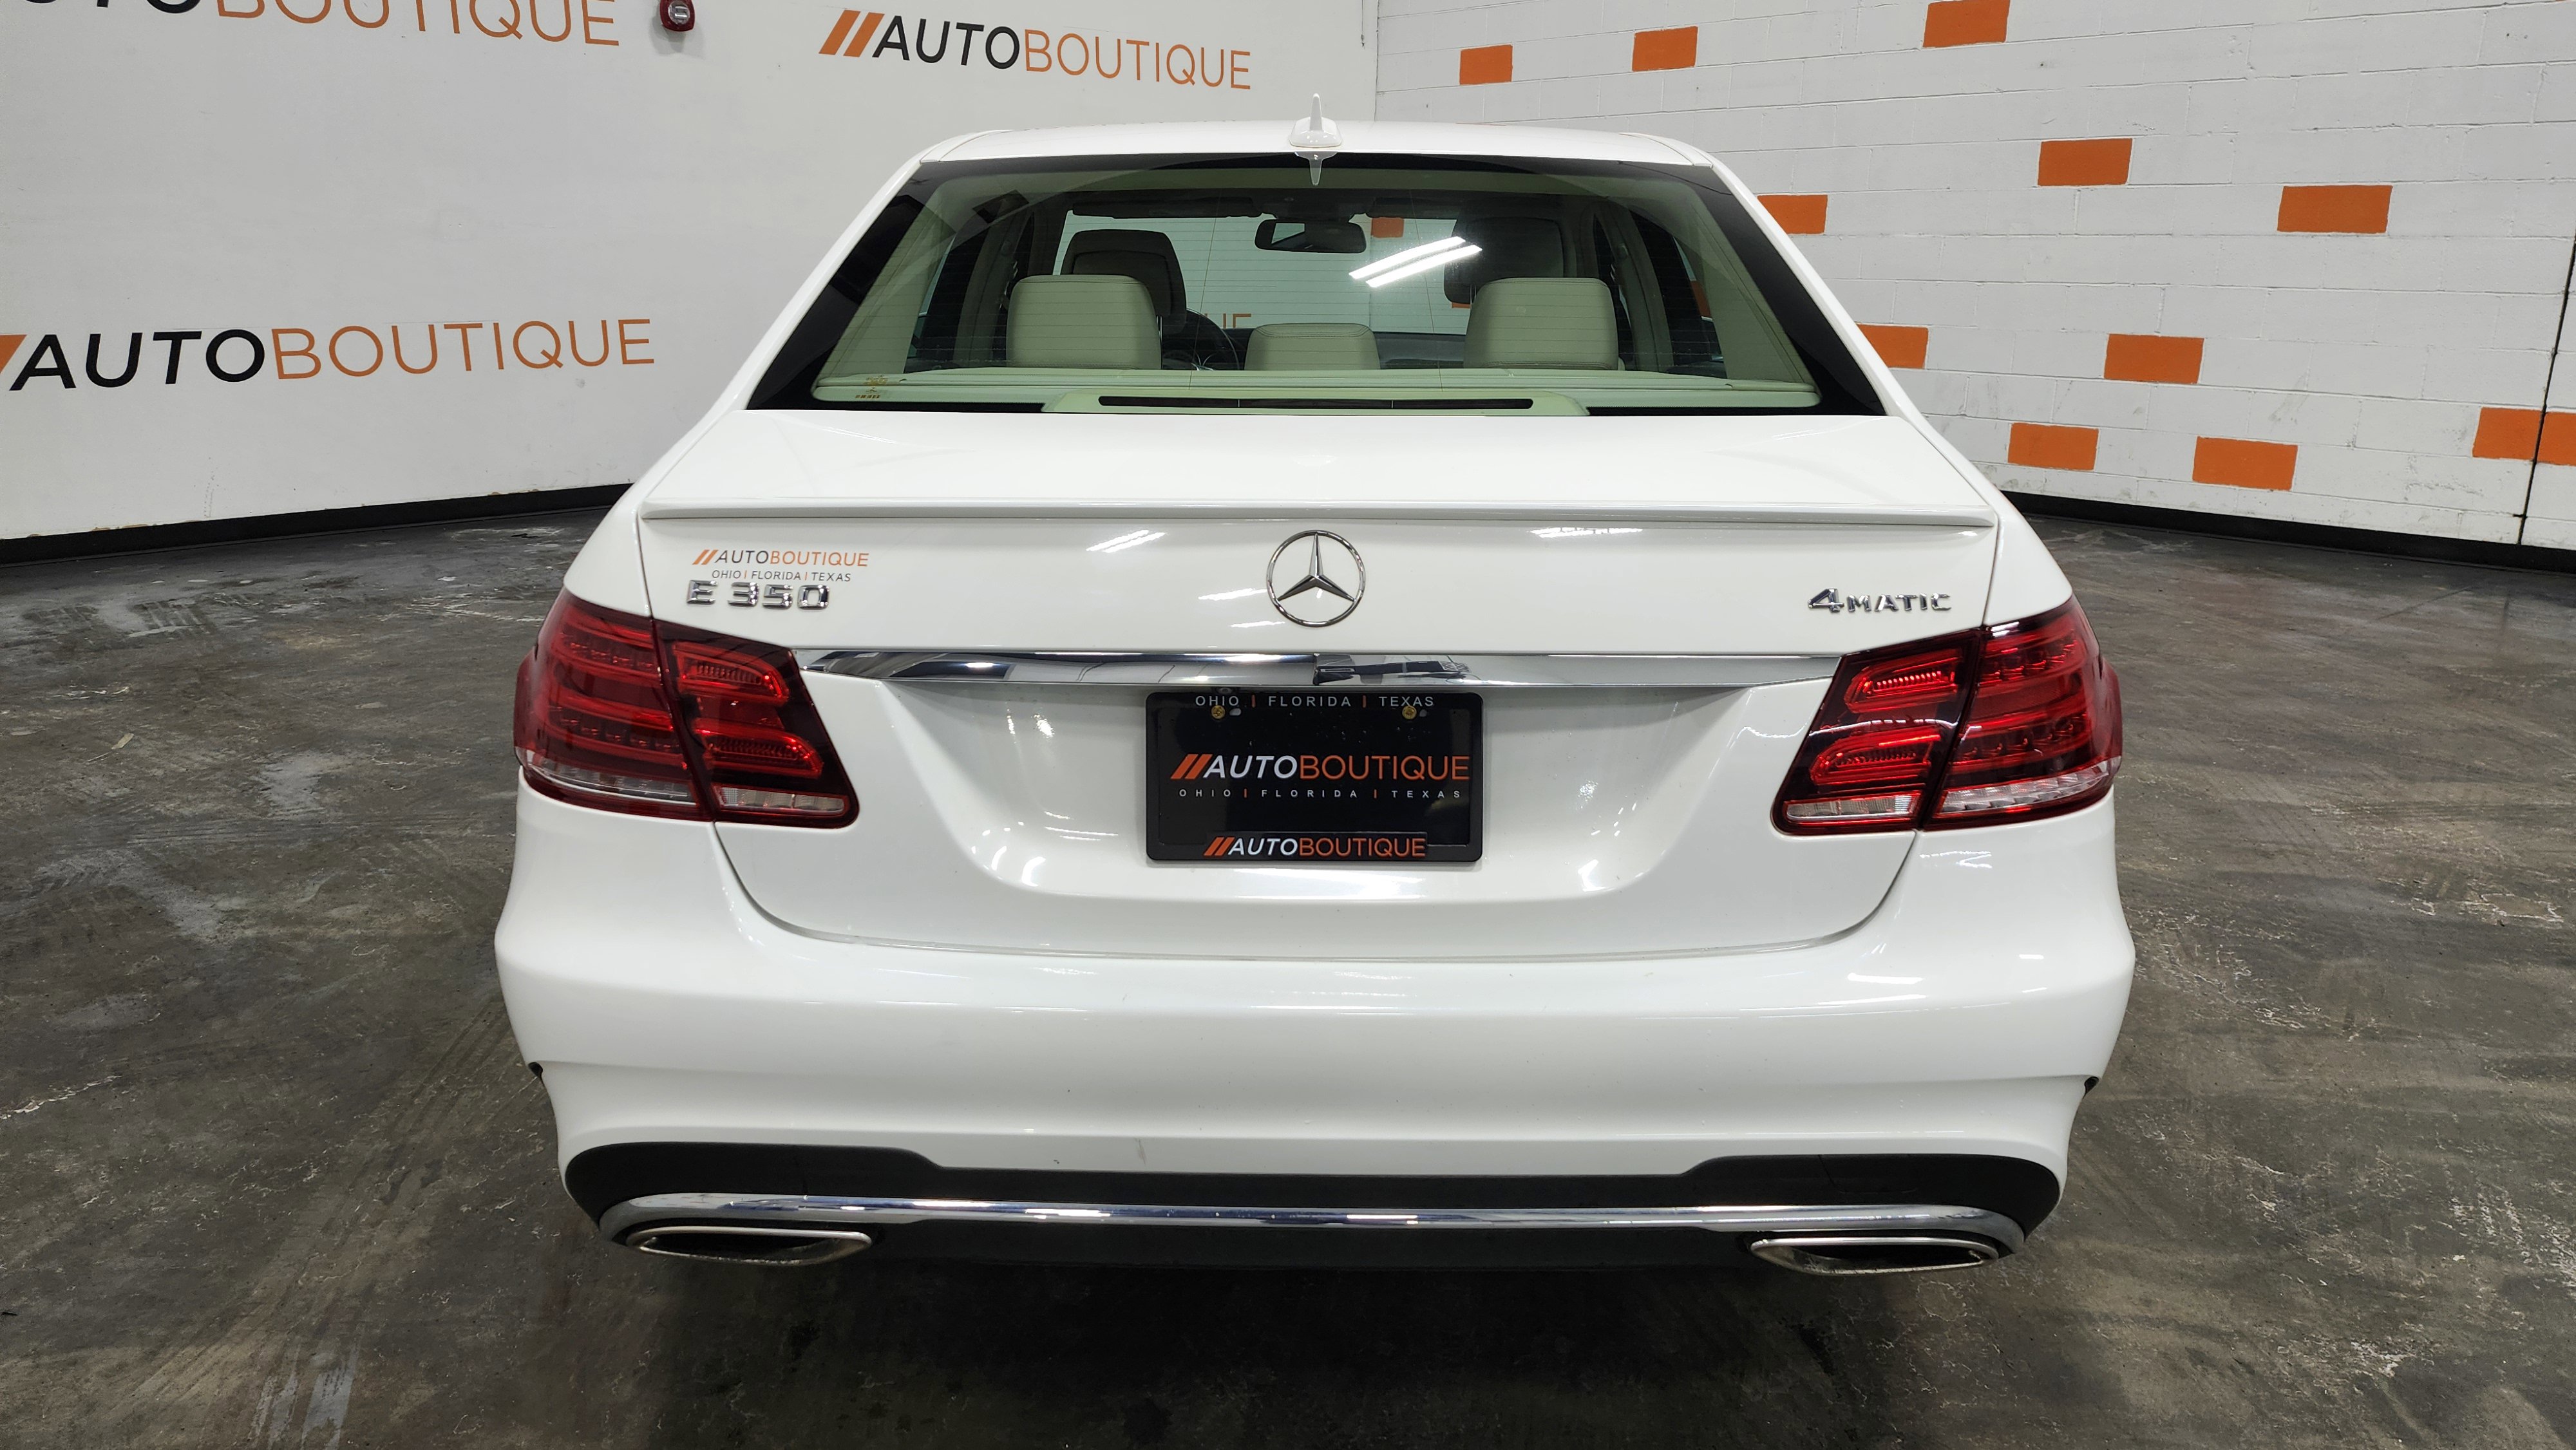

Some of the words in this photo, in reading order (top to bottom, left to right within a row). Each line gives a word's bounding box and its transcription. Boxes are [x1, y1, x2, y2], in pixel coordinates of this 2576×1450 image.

[872, 15, 1251, 89] AUTOBOUTIQUE
[10, 319, 654, 391] AUTOBOUTIQUE
[714, 549, 869, 567] AUTOBOUTIQUE
[712, 570, 741, 579] OHIO
[751, 570, 801, 580] FLORIDA
[811, 572, 851, 582] TEXAS
[686, 579, 718, 605] E
[727, 581, 830, 610] 350
[1808, 588, 1952, 612] 4MATIC
[1195, 695, 1239, 707] OHIO
[1268, 696, 1352, 707] FLORIDA
[1379, 696, 1434, 707] TEXAS
[1203, 755, 1471, 780] AUTOBOUTIQUE
[1179, 789, 1231, 798] OHIO
[1262, 789, 1357, 798] FLORIDA
[1391, 790, 1461, 799] TEXAS
[1228, 838, 1426, 858] AUTOBOUTIQUE
